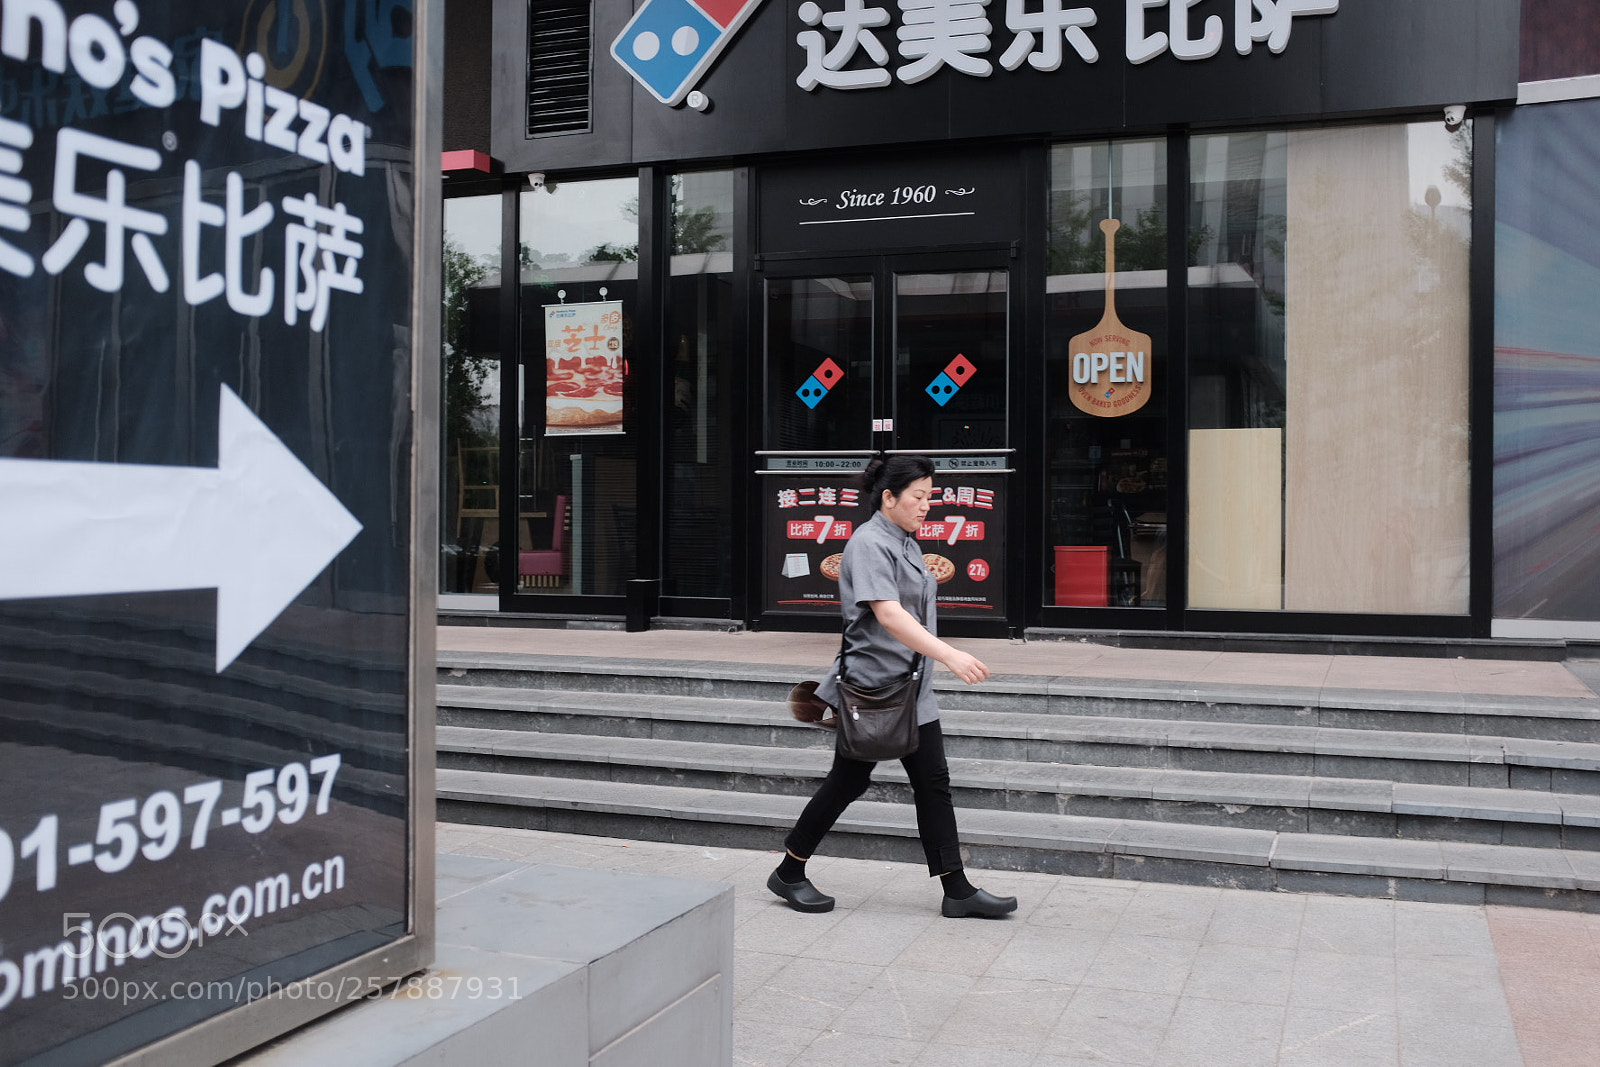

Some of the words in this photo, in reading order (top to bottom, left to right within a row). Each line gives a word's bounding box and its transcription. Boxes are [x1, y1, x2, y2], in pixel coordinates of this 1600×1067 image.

[200, 37, 366, 177] Pizza
[835, 189, 885, 210] Since
[890, 185, 937, 206] 1960
[1072, 351, 1144, 384] OPEN
[777, 486, 860, 508] 接二连三
